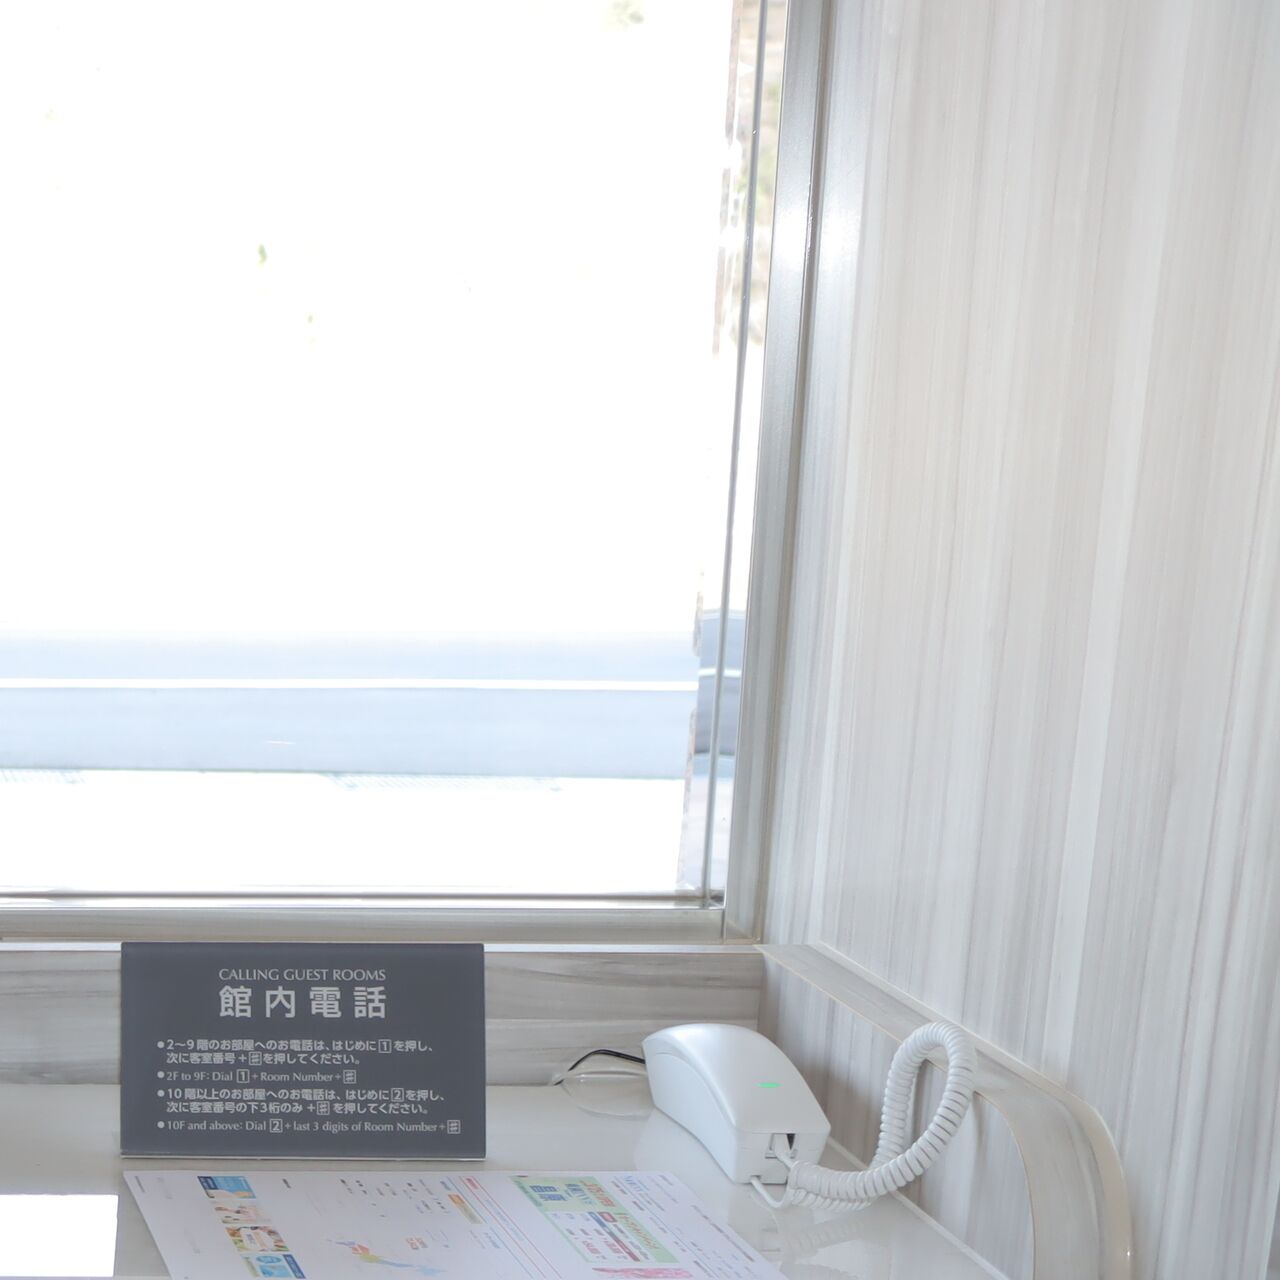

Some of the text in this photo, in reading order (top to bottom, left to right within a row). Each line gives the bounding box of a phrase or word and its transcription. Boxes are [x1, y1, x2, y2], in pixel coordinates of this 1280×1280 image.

[219, 969, 386, 981] CALLING GUEST ROOMS
[219, 985, 387, 1019] 館内電話
[167, 1071, 179, 1081] 2F
[181, 1072, 191, 1081] to
[194, 1071, 210, 1081] 9F:
[212, 1071, 233, 1081] Dial
[261, 1071, 290, 1081] Room
[167, 1121, 184, 1131] 10F
[187, 1121, 207, 1131] and
[209, 1121, 243, 1131] above:
[246, 1121, 266, 1131] Dial
[293, 1121, 310, 1131] last
[313, 1122, 320, 1131] 3
[322, 1121, 350, 1134] digits
[353, 1121, 362, 1131] of
[364, 1122, 392, 1131] Room
